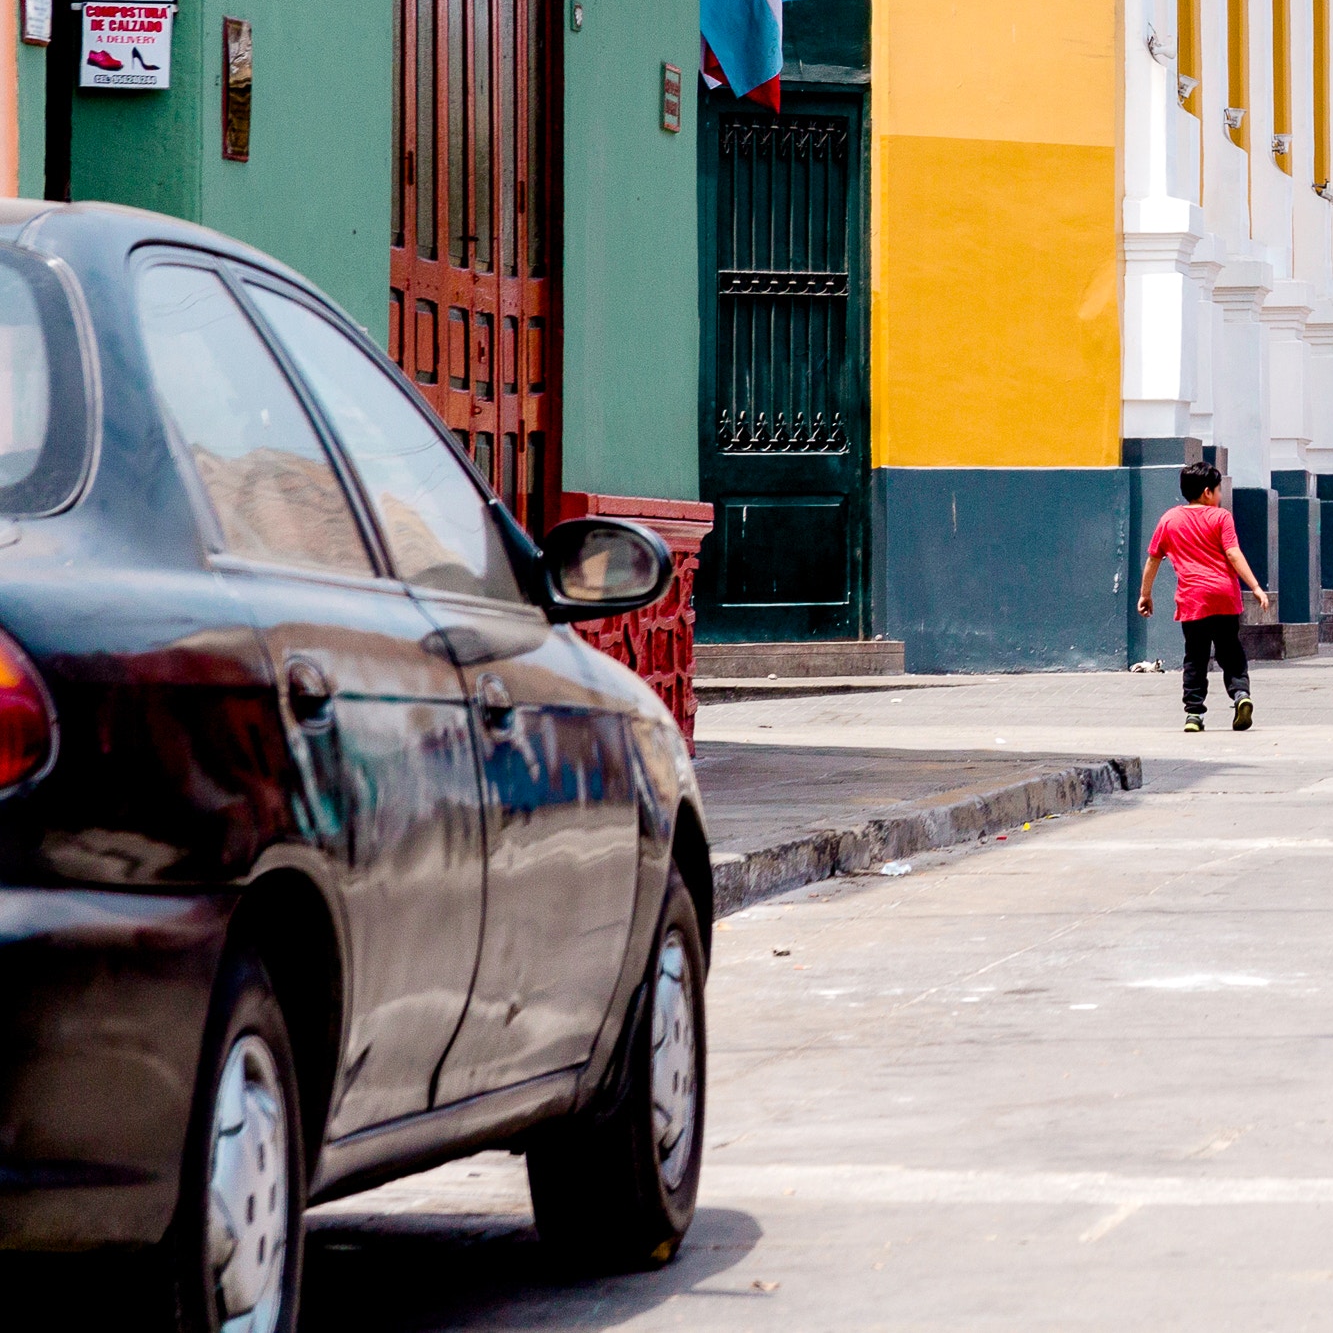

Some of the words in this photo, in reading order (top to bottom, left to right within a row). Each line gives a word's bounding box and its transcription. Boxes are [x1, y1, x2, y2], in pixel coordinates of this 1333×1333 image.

[86, 5, 168, 19] COMPOSTURA
[90, 19, 104, 31] DE
[109, 20, 162, 32] CALZADO
[96, 35, 103, 43] A
[107, 35, 155, 44] DELIVERY
